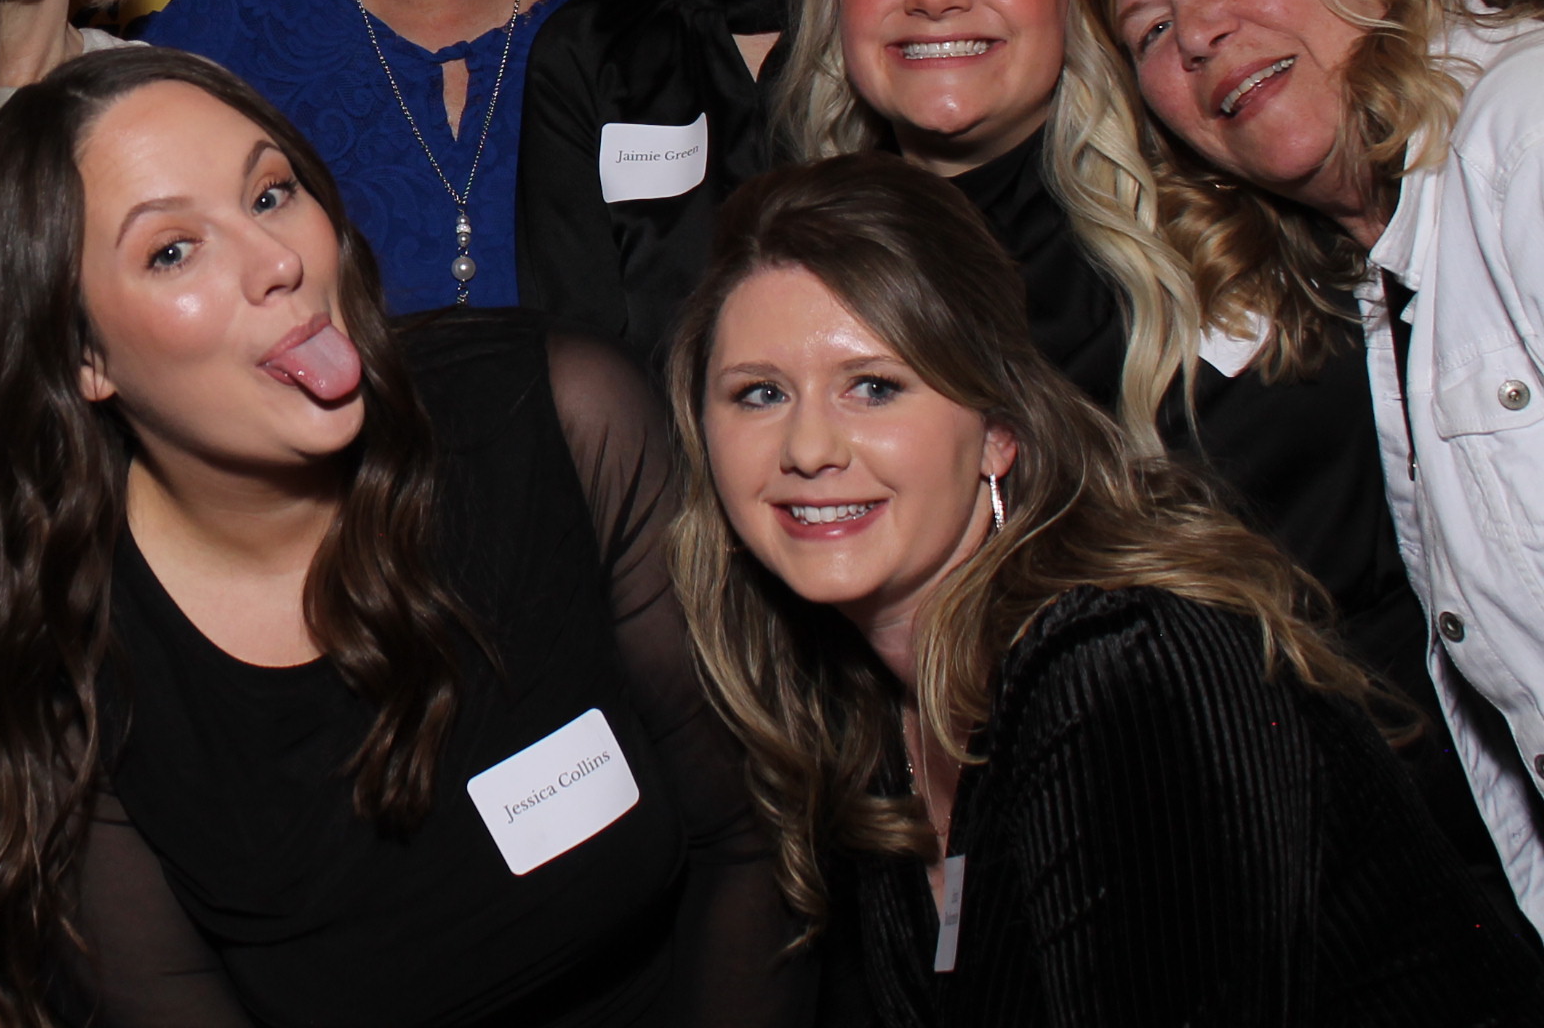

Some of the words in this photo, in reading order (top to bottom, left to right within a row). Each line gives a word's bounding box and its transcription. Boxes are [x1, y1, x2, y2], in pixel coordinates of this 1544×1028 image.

[615, 149, 661, 163] Jaimie
[664, 145, 699, 161] Green
[504, 783, 557, 824] Jessica
[557, 750, 611, 789] Collins
